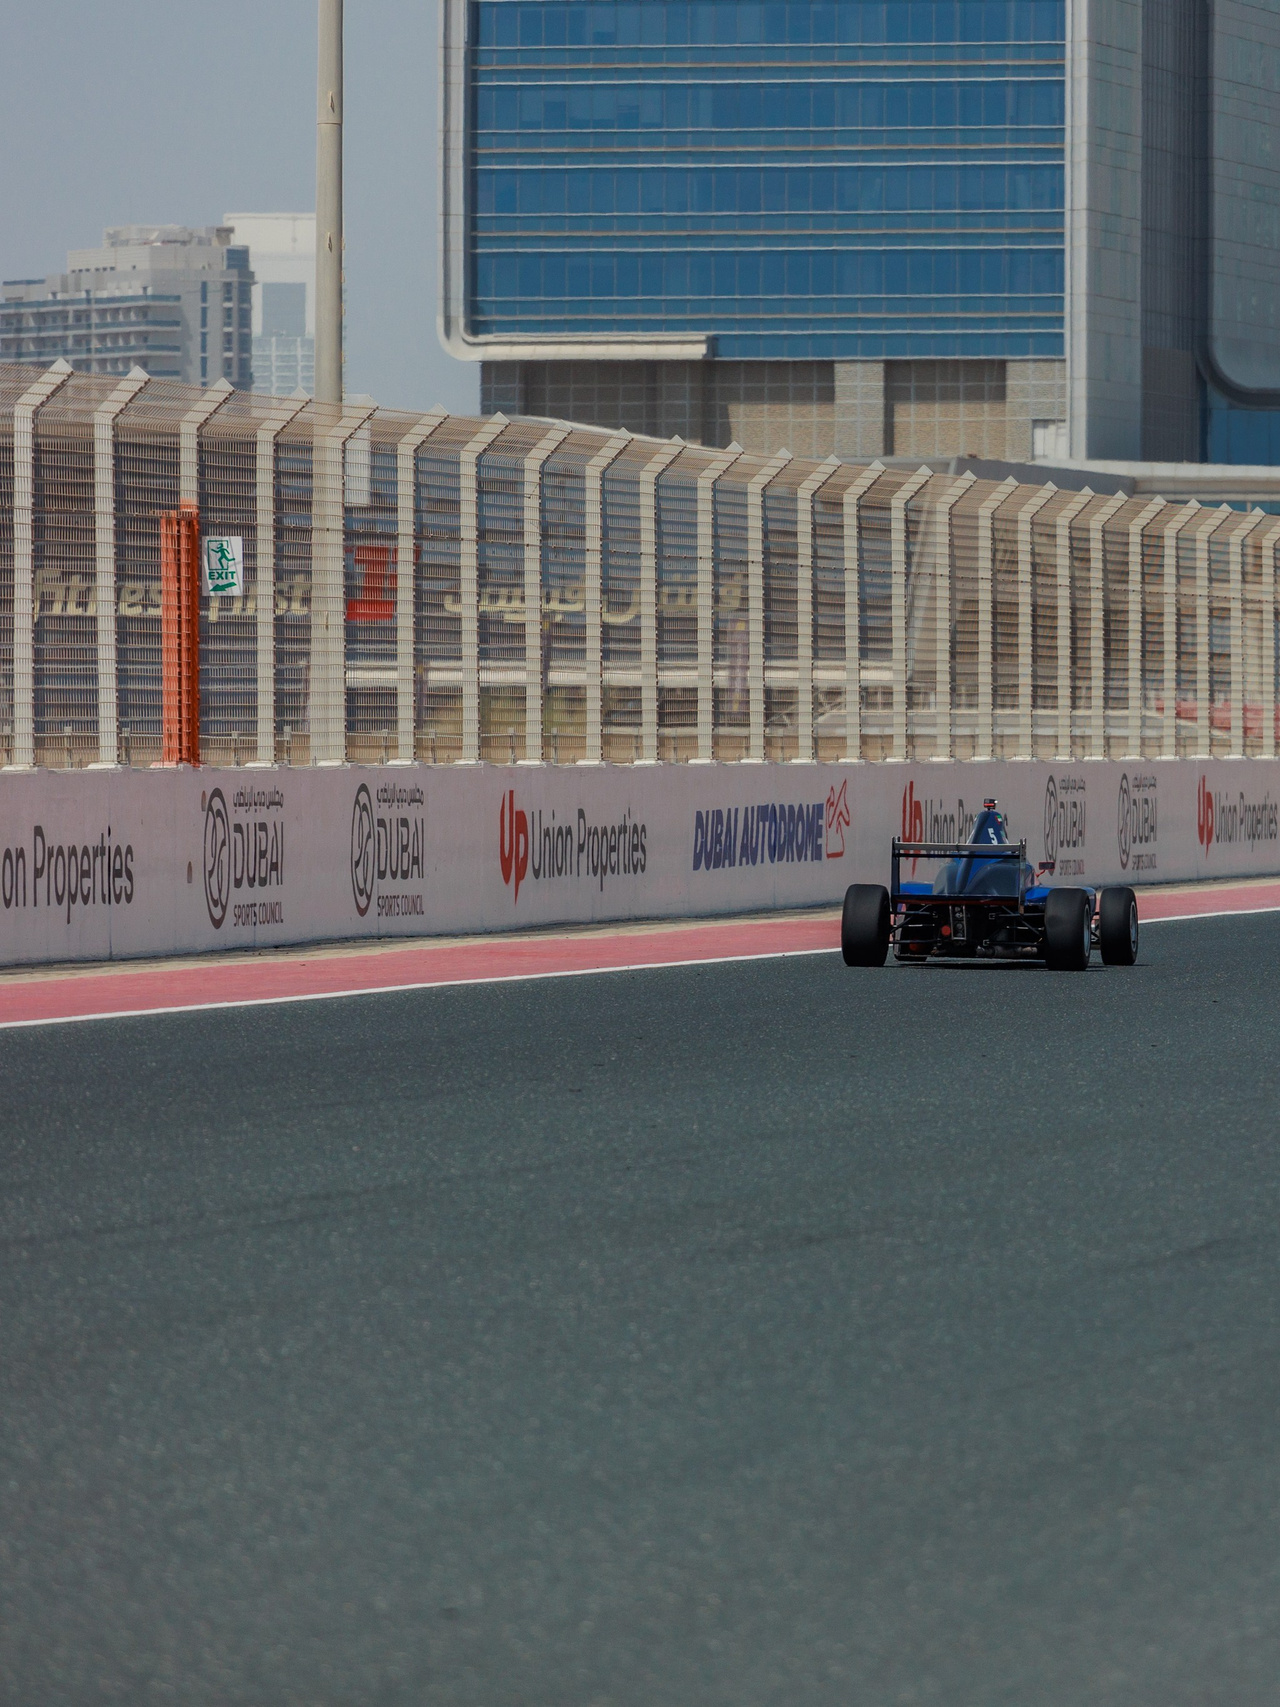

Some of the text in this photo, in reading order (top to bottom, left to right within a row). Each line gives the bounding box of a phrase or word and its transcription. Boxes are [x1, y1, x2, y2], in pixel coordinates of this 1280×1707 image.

[208, 571, 236, 580] EXIT
[377, 817, 425, 881] DUBAI
[693, 802, 824, 872] DUBAI AUTODROME
[925, 799, 955, 856] Union
[987, 827, 999, 845] 5
[1059, 801, 1086, 848] DUBAI
[1132, 797, 1157, 844] DUBAI
[1215, 792, 1237, 843] Union
[1239, 790, 1278, 852] Properties
[33, 824, 135, 925] Properties
[233, 821, 284, 890] DUBAI
[531, 809, 573, 880] Union
[577, 807, 647, 892] Properties
[233, 901, 284, 927] SPORTS COUNCIL
[377, 894, 425, 917] SPORTS COUNCIL
